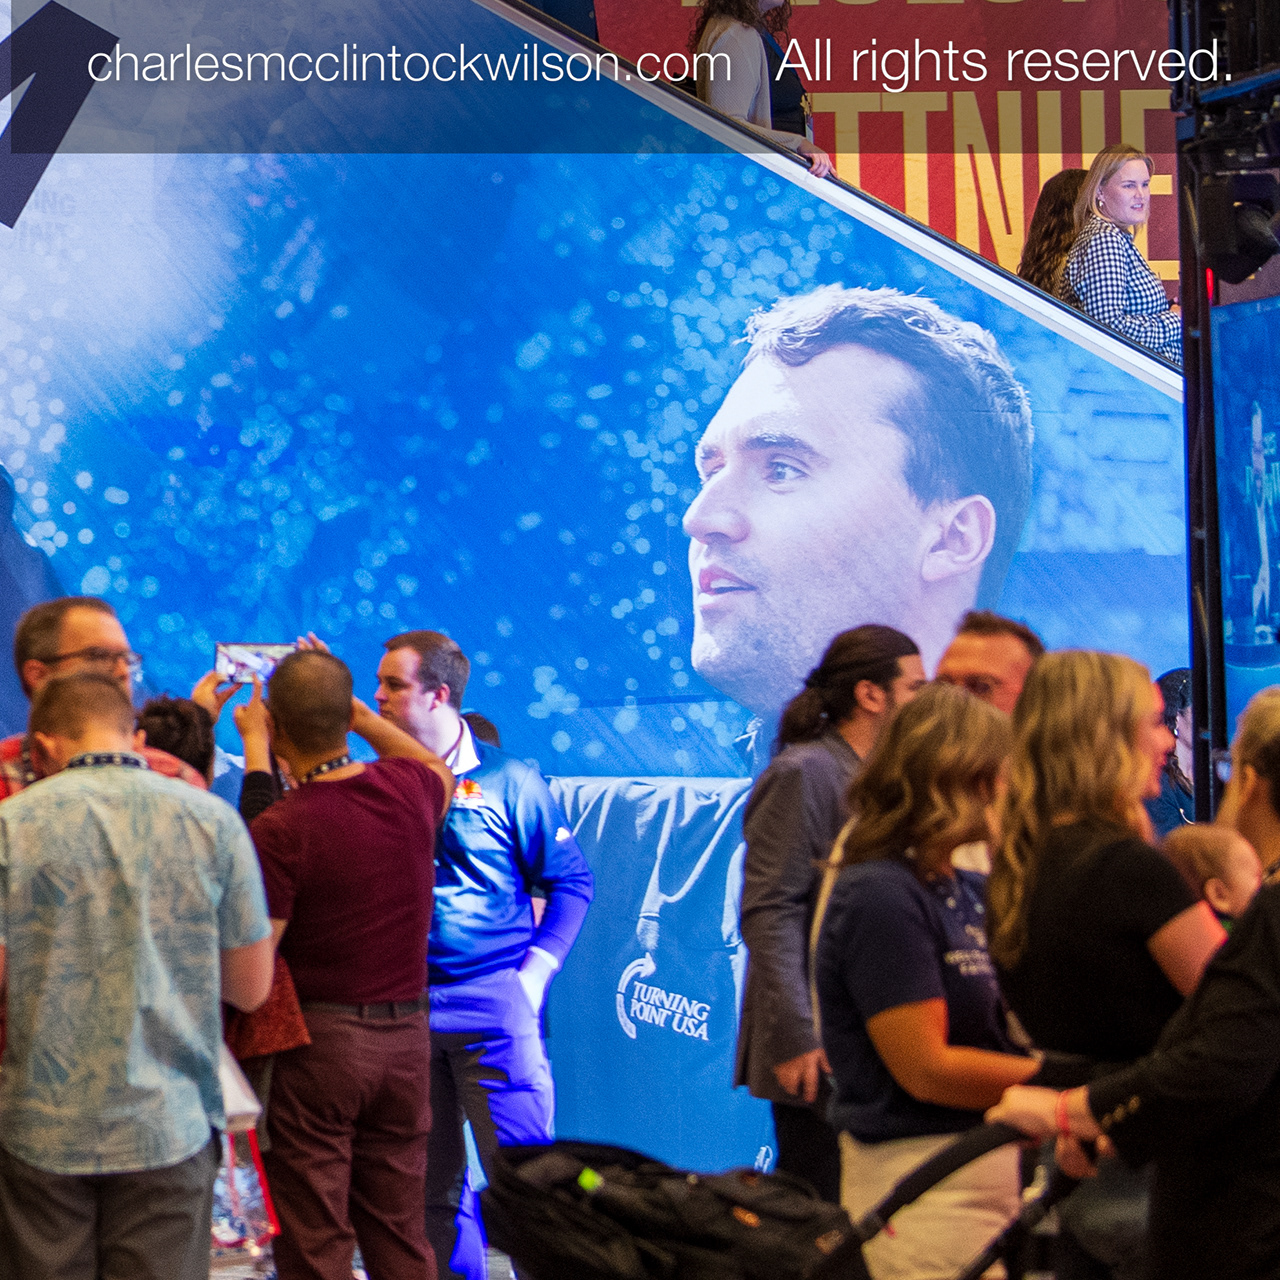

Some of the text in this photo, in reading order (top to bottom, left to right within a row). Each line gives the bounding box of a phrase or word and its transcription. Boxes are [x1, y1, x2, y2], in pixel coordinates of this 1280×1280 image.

[630, 998, 709, 1041] POINT USA
[633, 981, 711, 1021] TURNING
